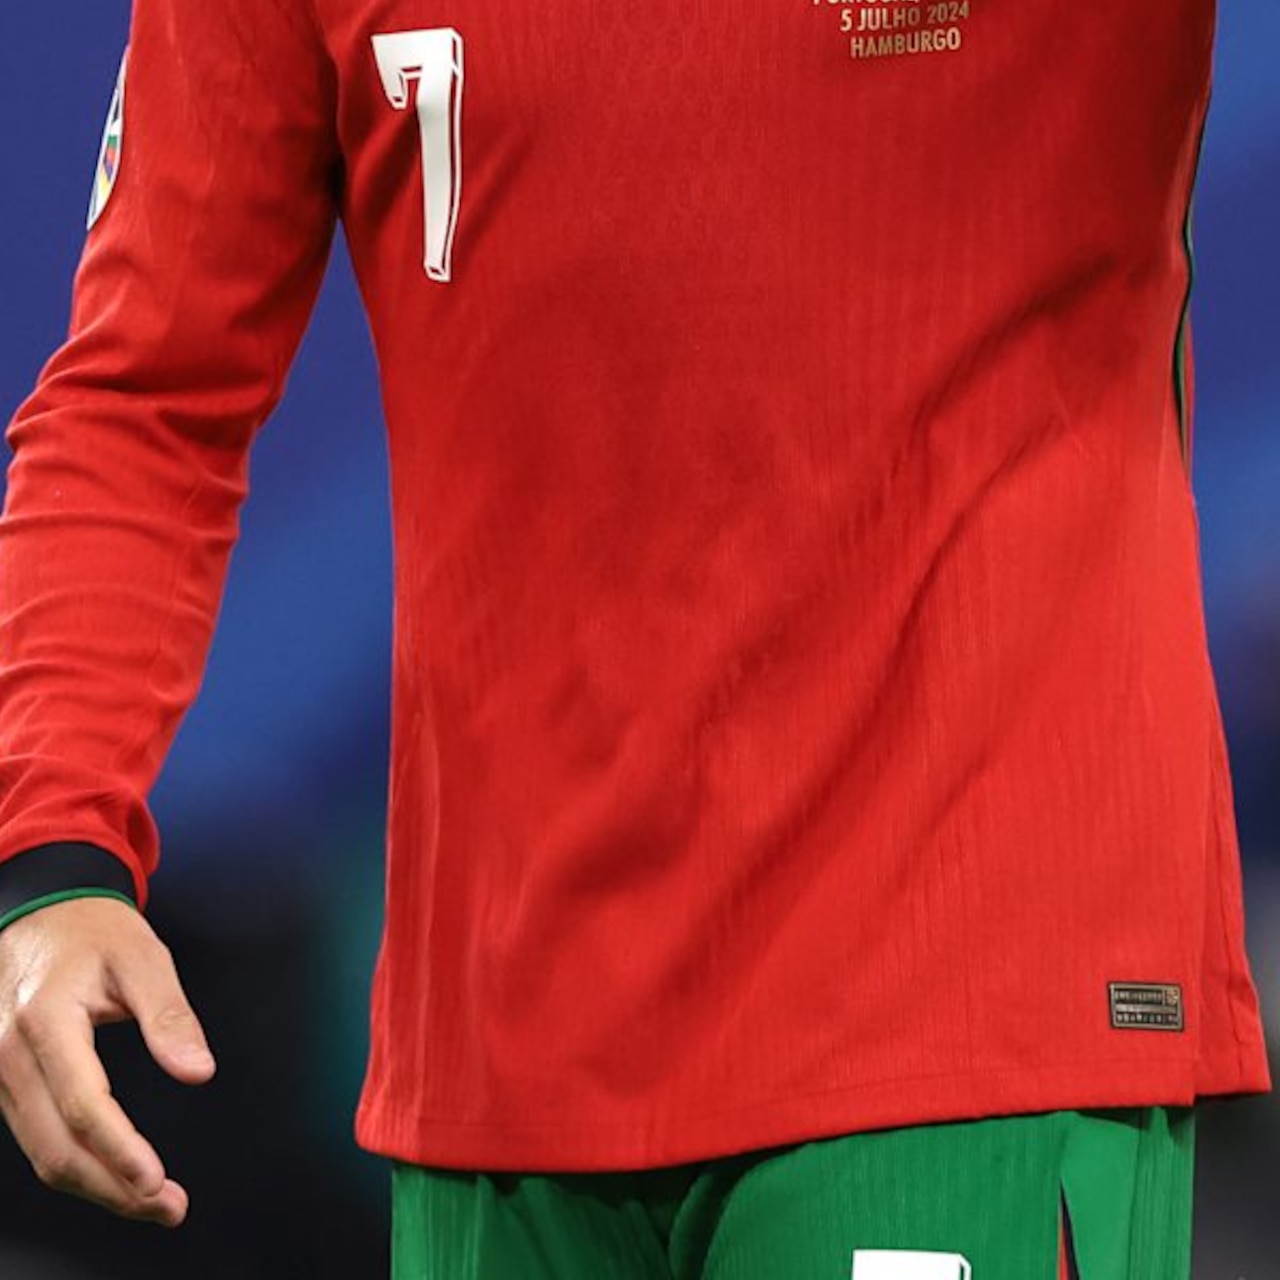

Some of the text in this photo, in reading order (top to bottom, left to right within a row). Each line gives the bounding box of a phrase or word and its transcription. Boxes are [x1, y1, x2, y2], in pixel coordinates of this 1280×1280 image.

[840, 0, 970, 32] 5 JULHO 2024
[850, 26, 962, 59] HAMBURGO
[370, 26, 464, 282] 7
